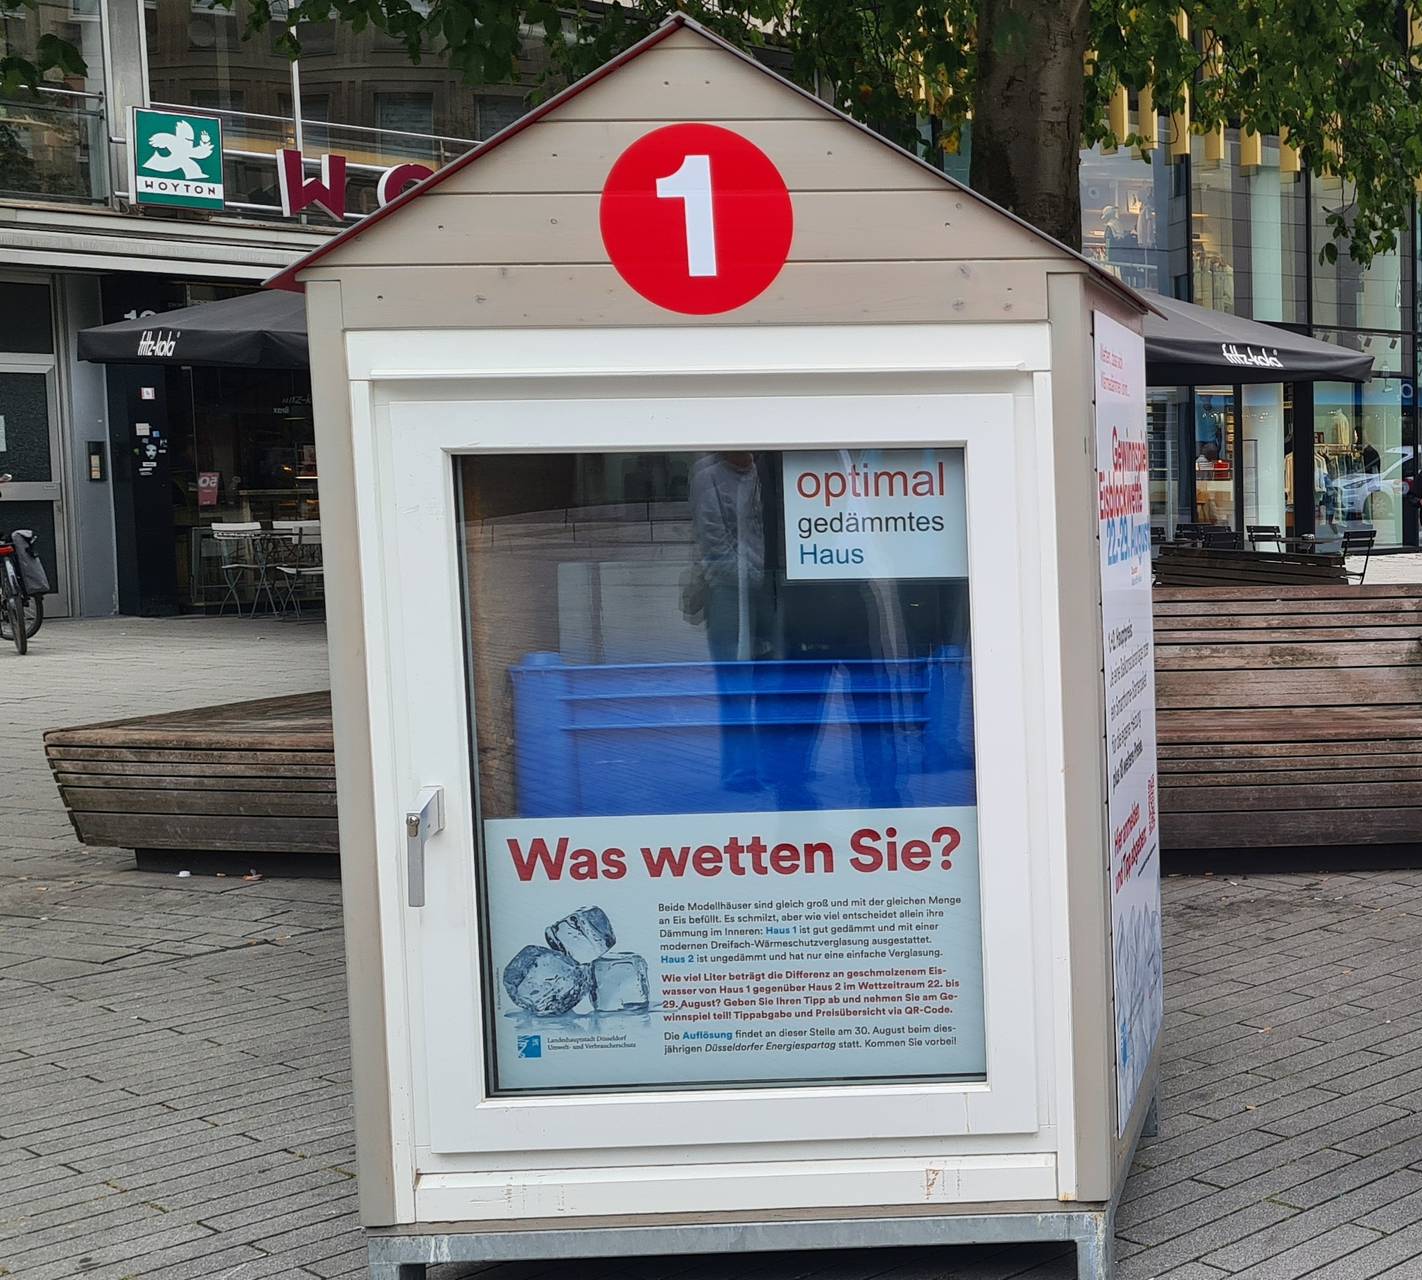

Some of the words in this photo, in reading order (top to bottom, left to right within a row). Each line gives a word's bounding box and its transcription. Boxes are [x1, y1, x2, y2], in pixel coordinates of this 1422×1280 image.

[145, 180, 216, 195] WOYTON
[656, 154, 718, 277] 1
[1222, 344, 1284, 368] fritz-kola
[1112, 425, 1147, 472] Gewinnspiel
[797, 462, 945, 507] optimal
[798, 512, 945, 539] gedämmtes
[800, 544, 865, 565] Haus
[506, 838, 628, 881] Was
[640, 836, 835, 877] wetten
[848, 827, 961, 873] Sie?
[662, 973, 681, 983] Wie
[682, 973, 701, 982] viel
[703, 972, 726, 982] Liter
[728, 971, 765, 983] beträgt
[767, 971, 784, 980] die
[785, 970, 830, 980] Differenz
[846, 967, 926, 980] geschmolzenem
[928, 967, 947, 976] Eis-
[662, 988, 697, 996] wasser
[719, 985, 744, 994] Haus
[752, 983, 806, 996] gegenüber
[808, 982, 832, 992] Haus
[844, 982, 855, 991] im
[858, 980, 925, 991] Wettzeitraum
[927, 980, 943, 989] 22.
[945, 979, 960, 989] bis
[662, 999, 678, 1009] 29.
[680, 998, 721, 1011] August?
[723, 997, 756, 1007] Geben
[758, 997, 773, 1006] Sie
[776, 996, 801, 1006] Ihren
[803, 996, 826, 1007] Tipp
[828, 995, 840, 1005] ab
[842, 995, 861, 1004] und
[863, 994, 902, 1004] nehmen
[904, 993, 920, 1003] Sie
[939, 992, 958, 1002] Ge-
